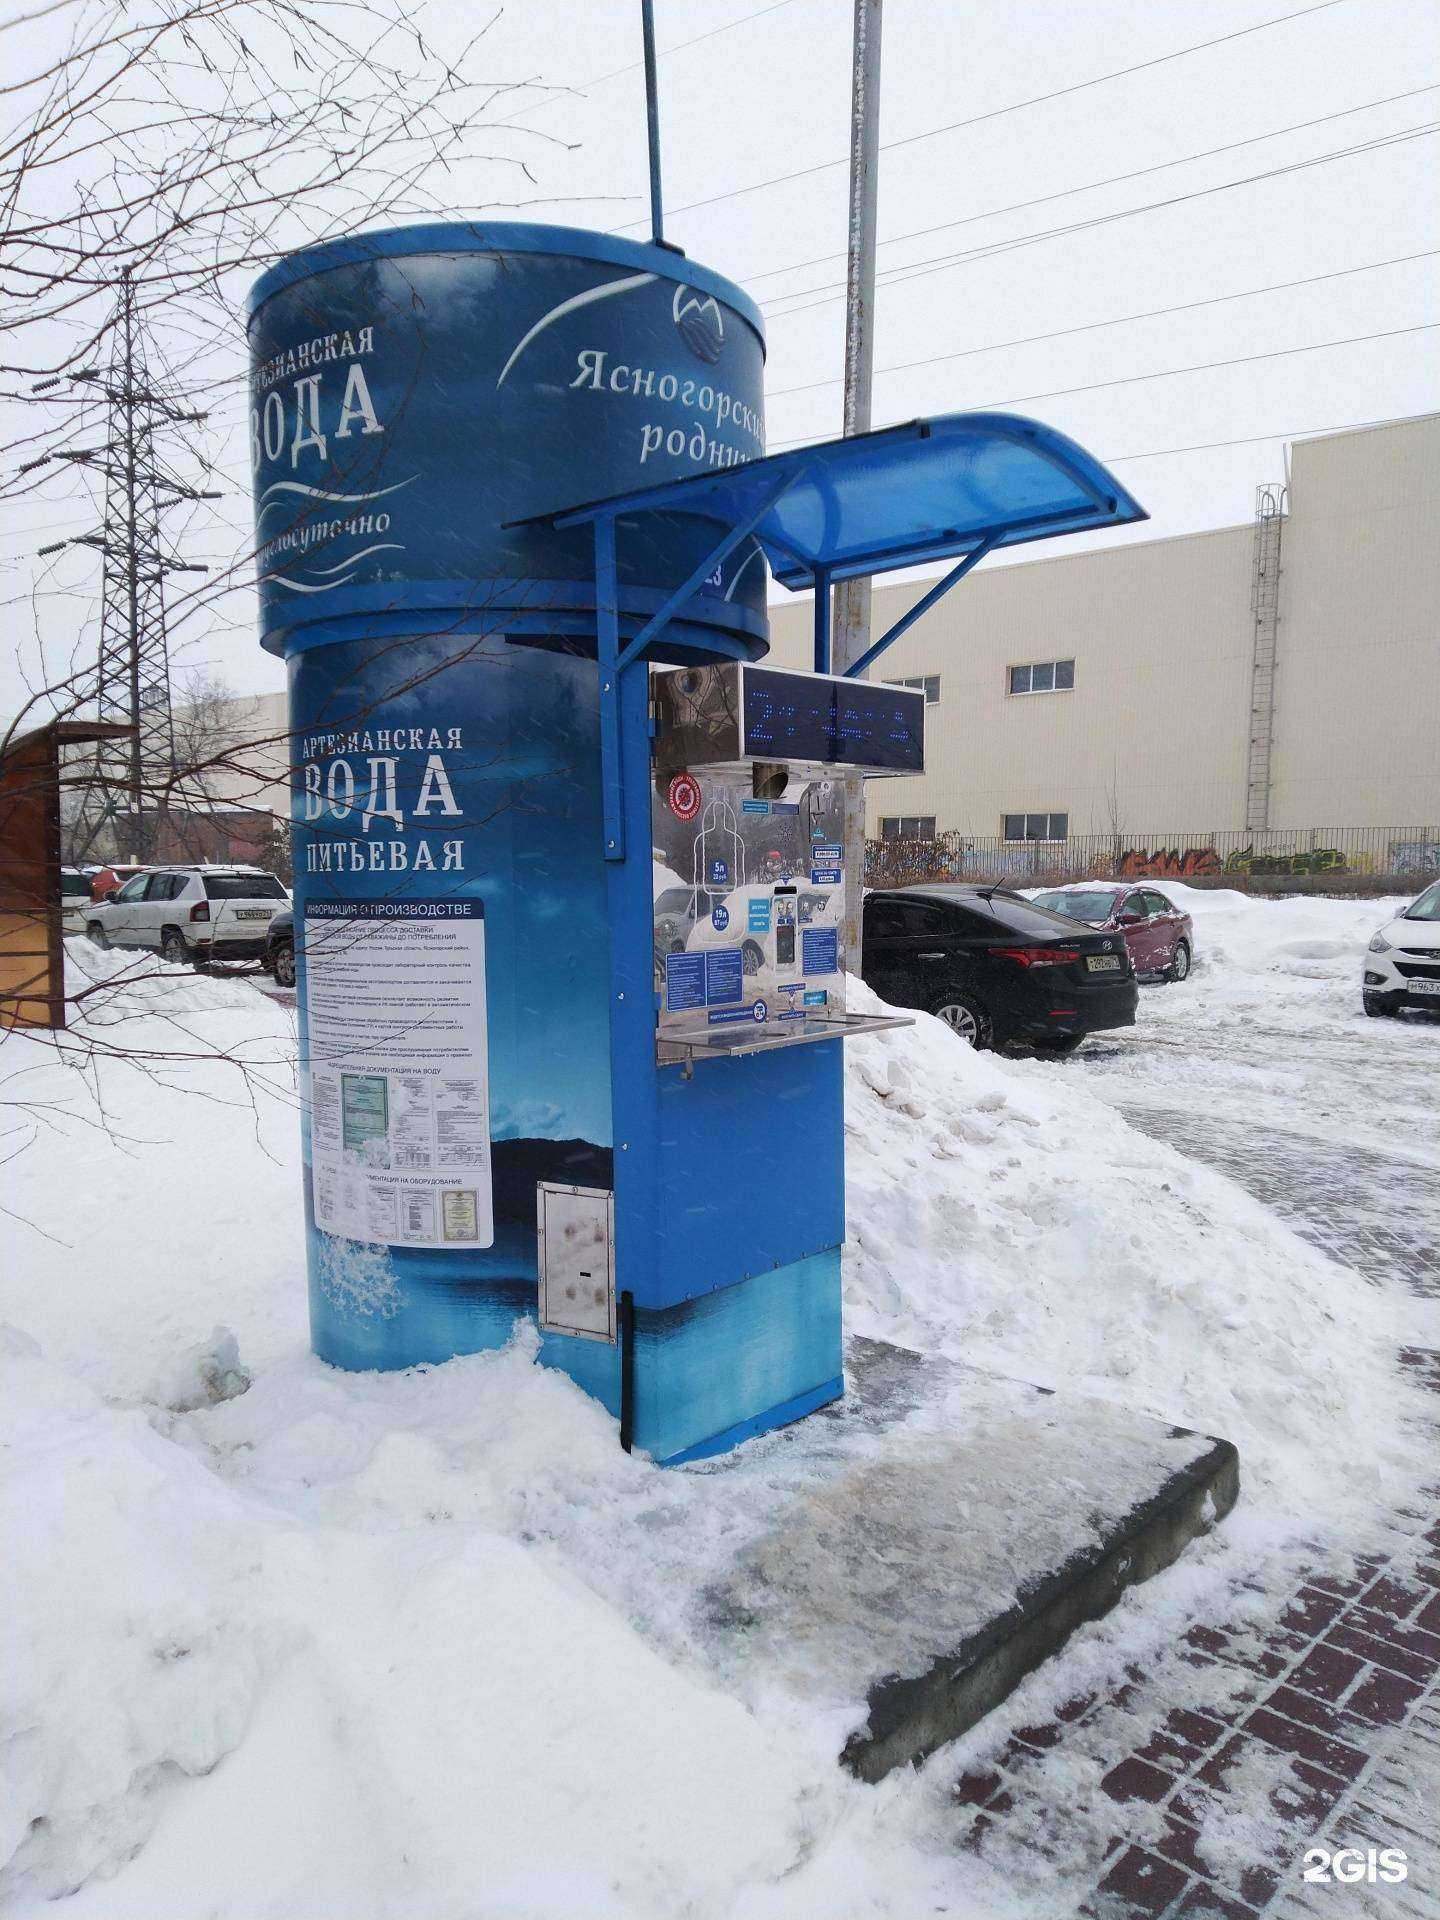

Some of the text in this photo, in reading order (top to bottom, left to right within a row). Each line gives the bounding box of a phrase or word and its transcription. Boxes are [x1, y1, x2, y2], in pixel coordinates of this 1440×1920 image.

[302, 728, 463, 759] АРТЕЗИАНСКАЯ
[304, 754, 464, 833] ВОДА
[306, 840, 465, 873] ПИТЬЕВАЯ
[370, 904, 472, 916] ПРОИЗВОДСТВЕ
